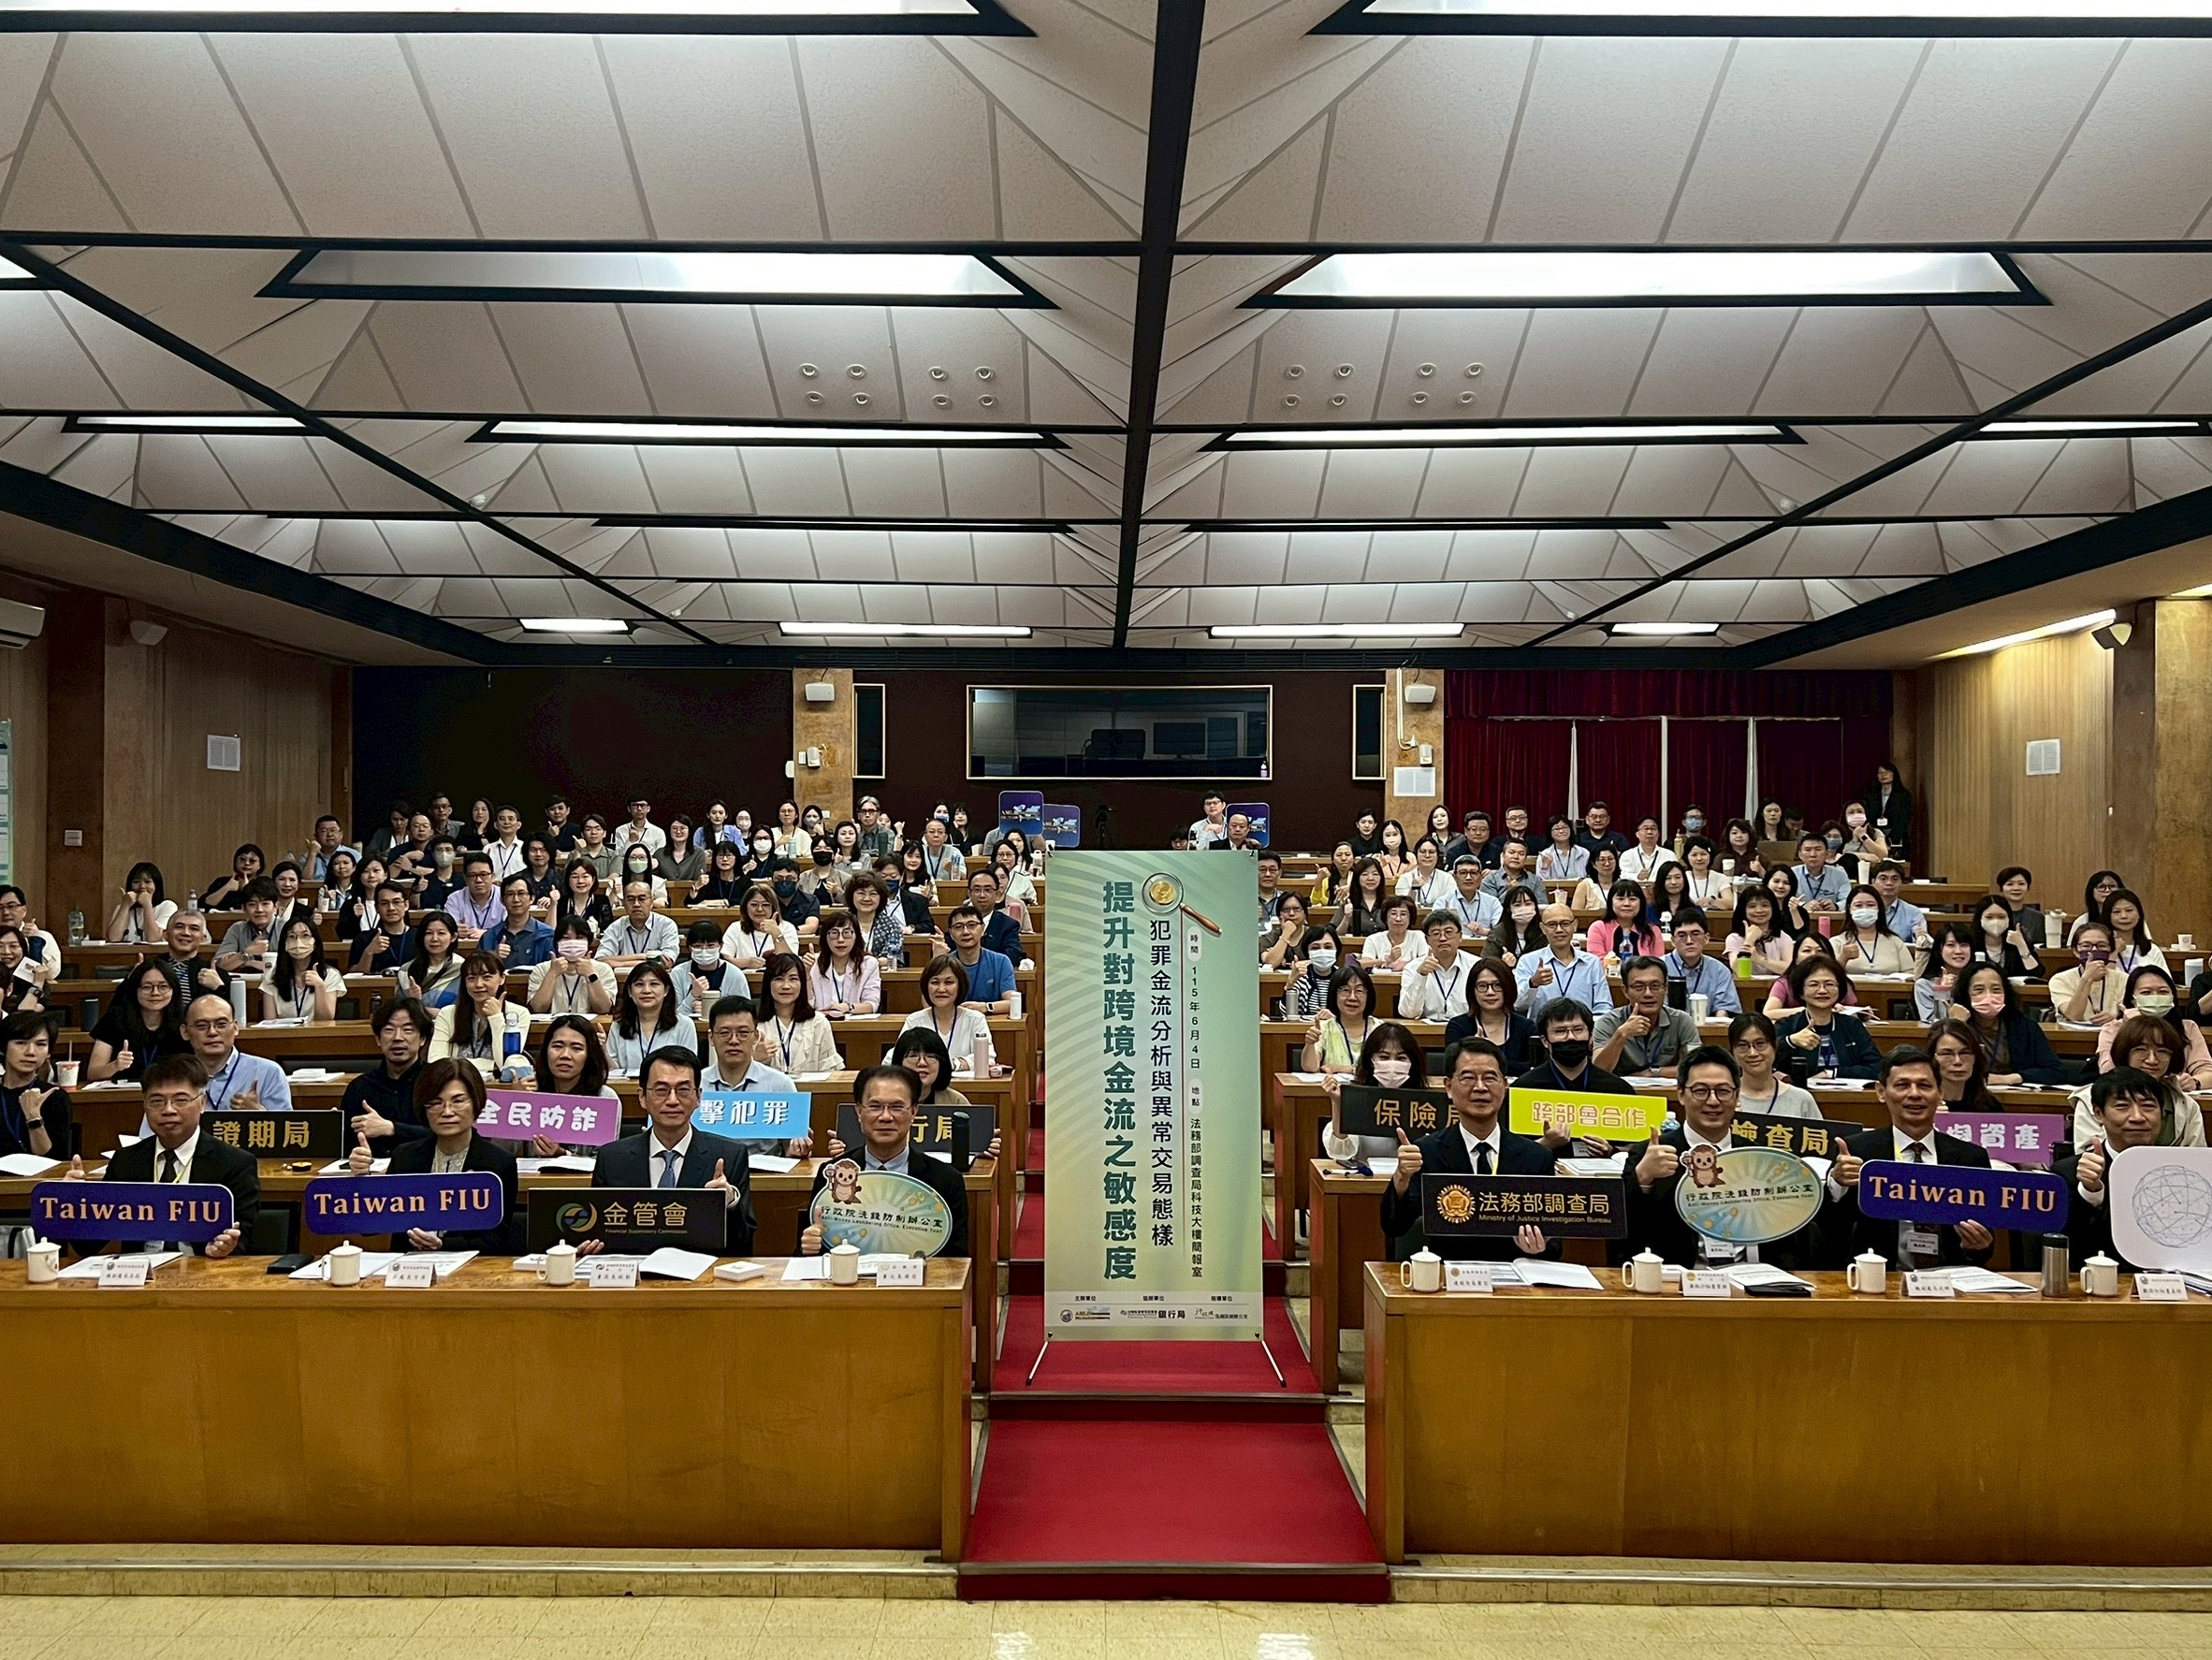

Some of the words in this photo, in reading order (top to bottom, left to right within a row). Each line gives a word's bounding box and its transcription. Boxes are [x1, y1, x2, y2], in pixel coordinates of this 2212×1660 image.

[1189, 934, 1200, 954] 時間
[1189, 966, 1201, 1070] 115年6月4日
[1102, 881, 1137, 1280] 提升對跨境金流之敏感度
[1150, 919, 1174, 1246] 犯罪金流分析與異常交易態樣
[1191, 1086, 1201, 1107] 地點
[476, 1099, 598, 1132] 全民防詐
[1532, 1100, 1647, 1129] 跨部會合作
[212, 1120, 311, 1149] 證期局
[313, 1191, 427, 1216] Taiwan
[438, 1187, 491, 1212] FIU
[1190, 1117, 1203, 1278] 法務部調查局科技大樓簡報室
[1478, 1191, 1610, 1216] 法務部調查局
[1868, 1175, 1986, 1208] Taiwan
[2000, 1186, 2057, 1213] FIU
[39, 1196, 155, 1222] Taiwan
[167, 1200, 222, 1223] FIU
[603, 1201, 689, 1227] 金管會
[1478, 1214, 1506, 1223] Ministry
[1541, 1216, 1586, 1225] Investigation
